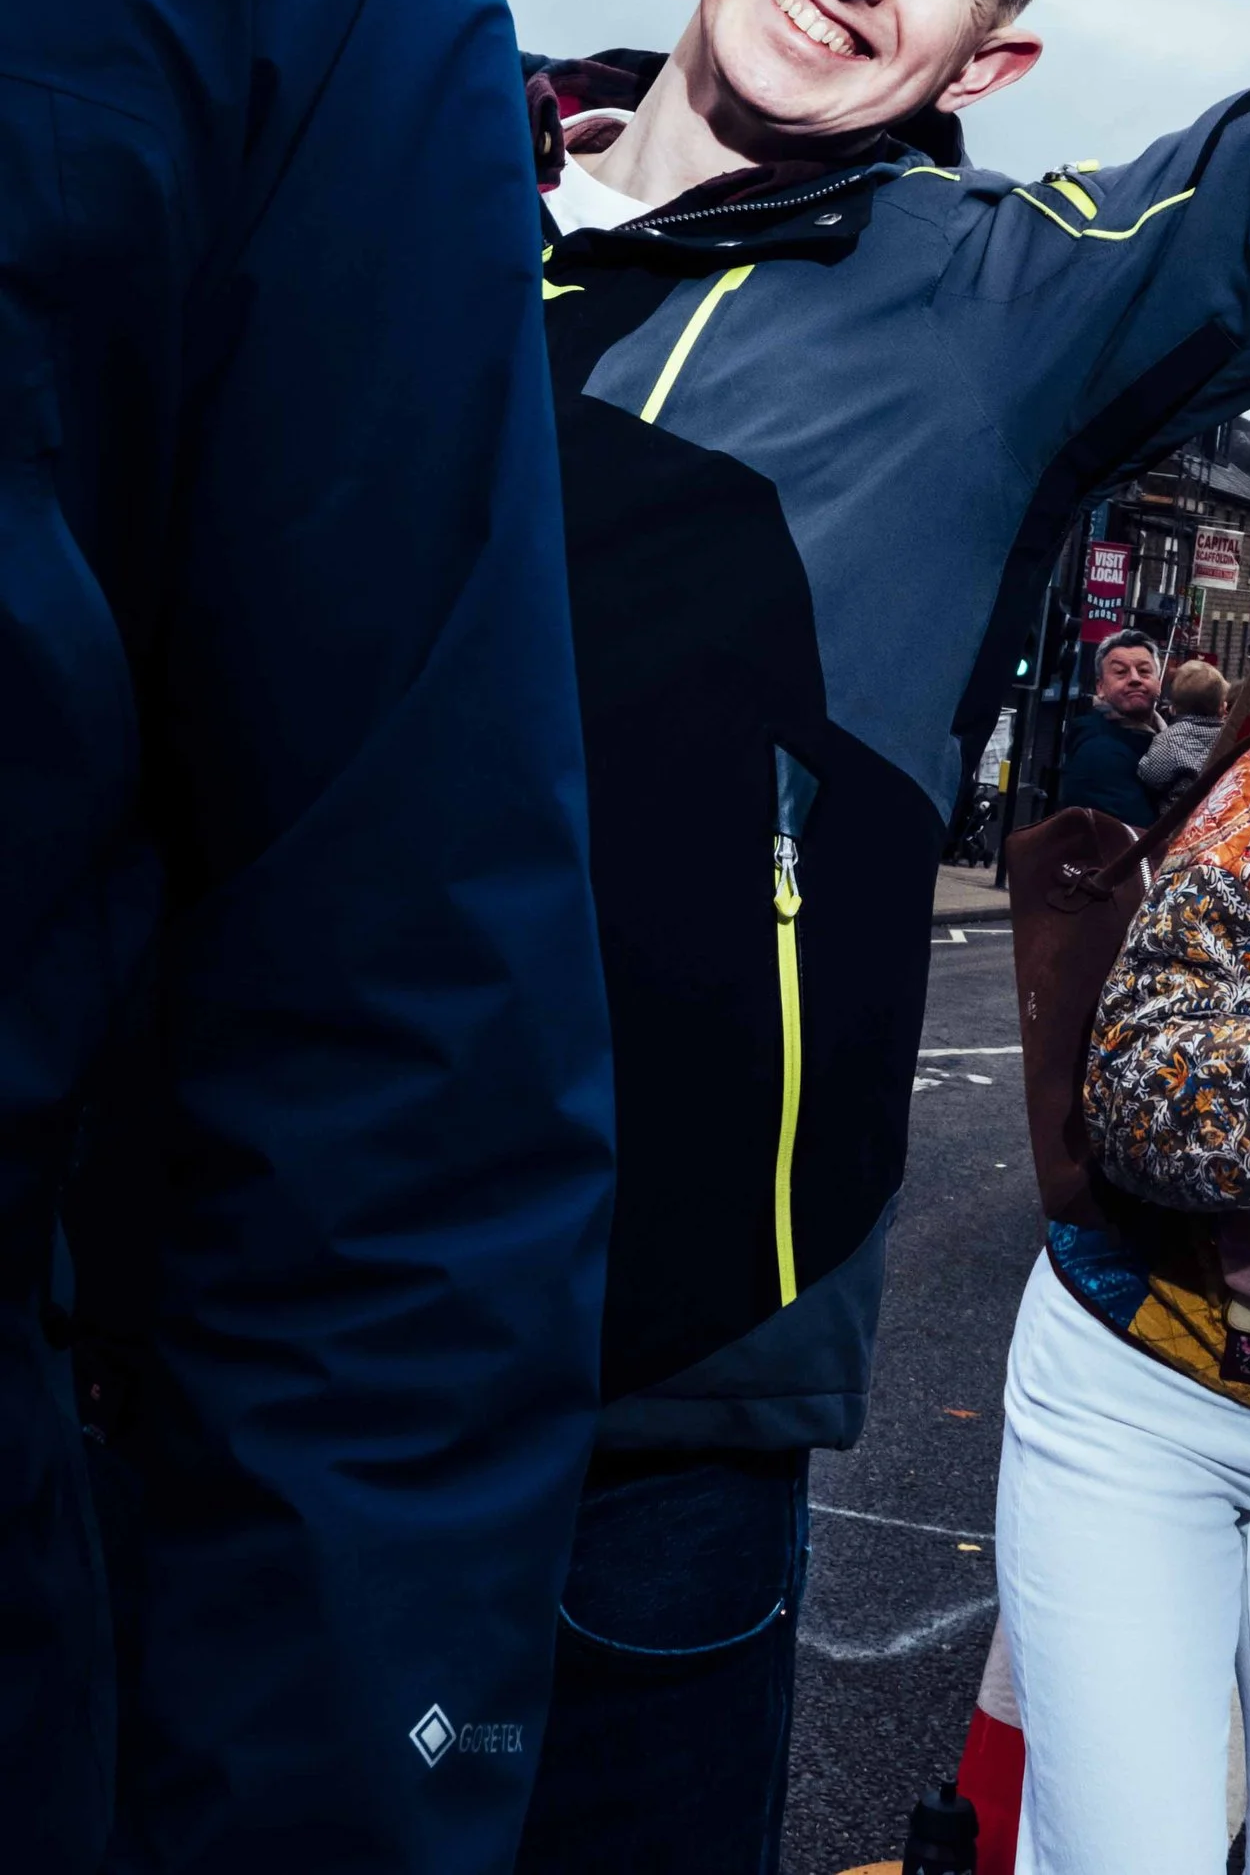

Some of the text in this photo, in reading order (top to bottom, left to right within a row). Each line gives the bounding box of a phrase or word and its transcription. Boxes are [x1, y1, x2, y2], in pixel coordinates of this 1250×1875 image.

[1197, 533, 1240, 554] CAPITAL
[1095, 551, 1126, 569] VISIT
[1090, 566, 1125, 585] LOCAL
[1087, 593, 1122, 608] BANNER
[1088, 609, 1118, 622] CROSS
[458, 1722, 524, 1754] GORE-TEX
